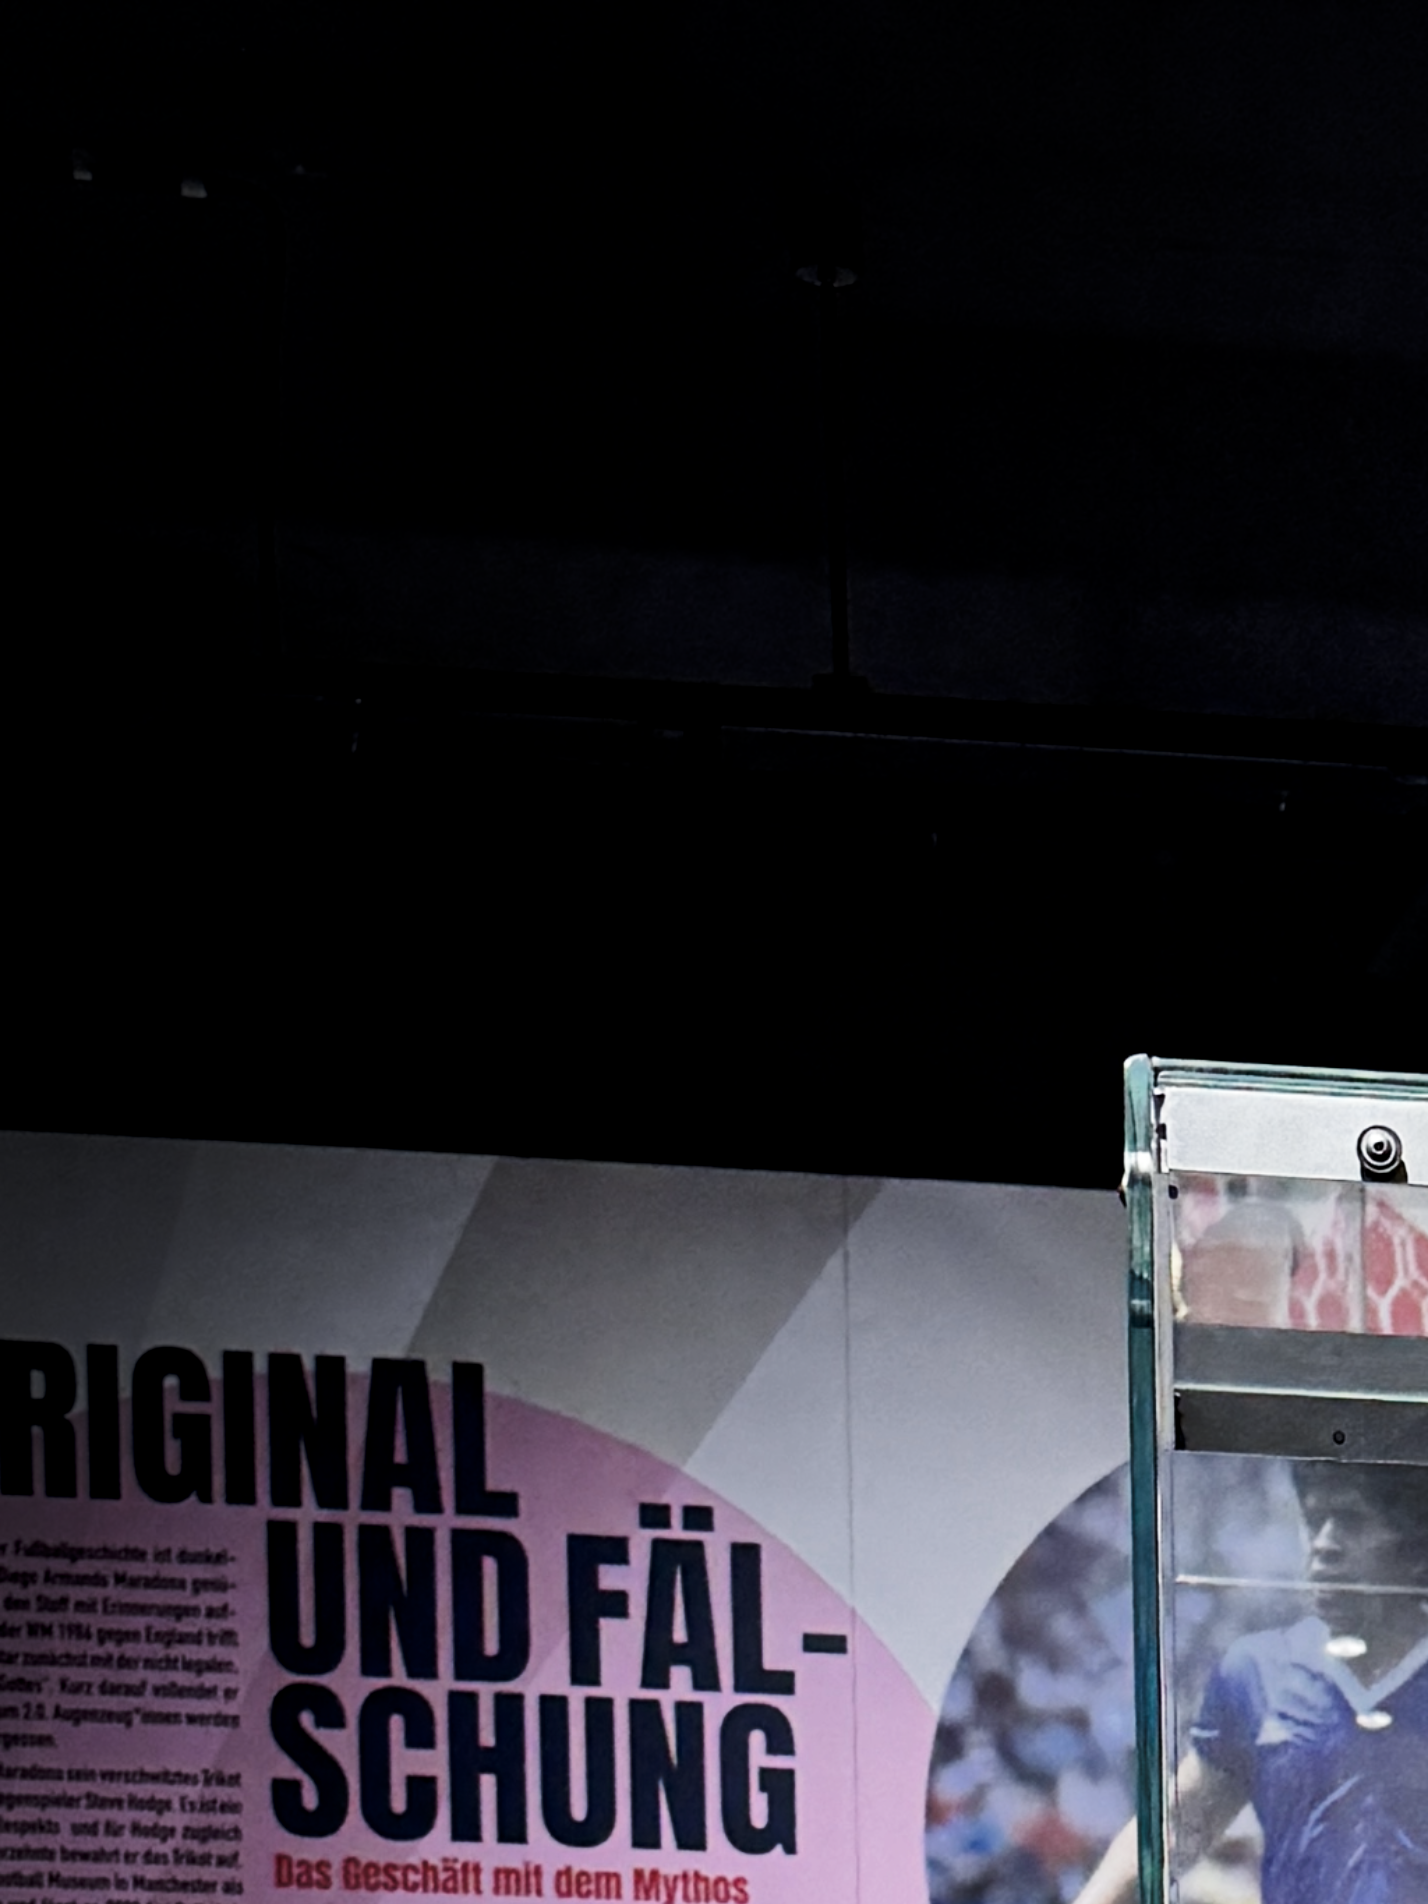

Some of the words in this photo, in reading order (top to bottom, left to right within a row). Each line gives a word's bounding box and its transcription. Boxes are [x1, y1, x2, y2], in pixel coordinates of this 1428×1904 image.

[0, 1339, 519, 1519] RIGINAL
[266, 1518, 529, 1684] UND
[566, 1502, 848, 1695] FÄL-
[269, 1683, 798, 1856] SCHUNG
[274, 1853, 332, 1891] Das
[342, 1856, 483, 1899] Geschäft
[493, 1861, 545, 1899] mit
[555, 1866, 623, 1902] dem
